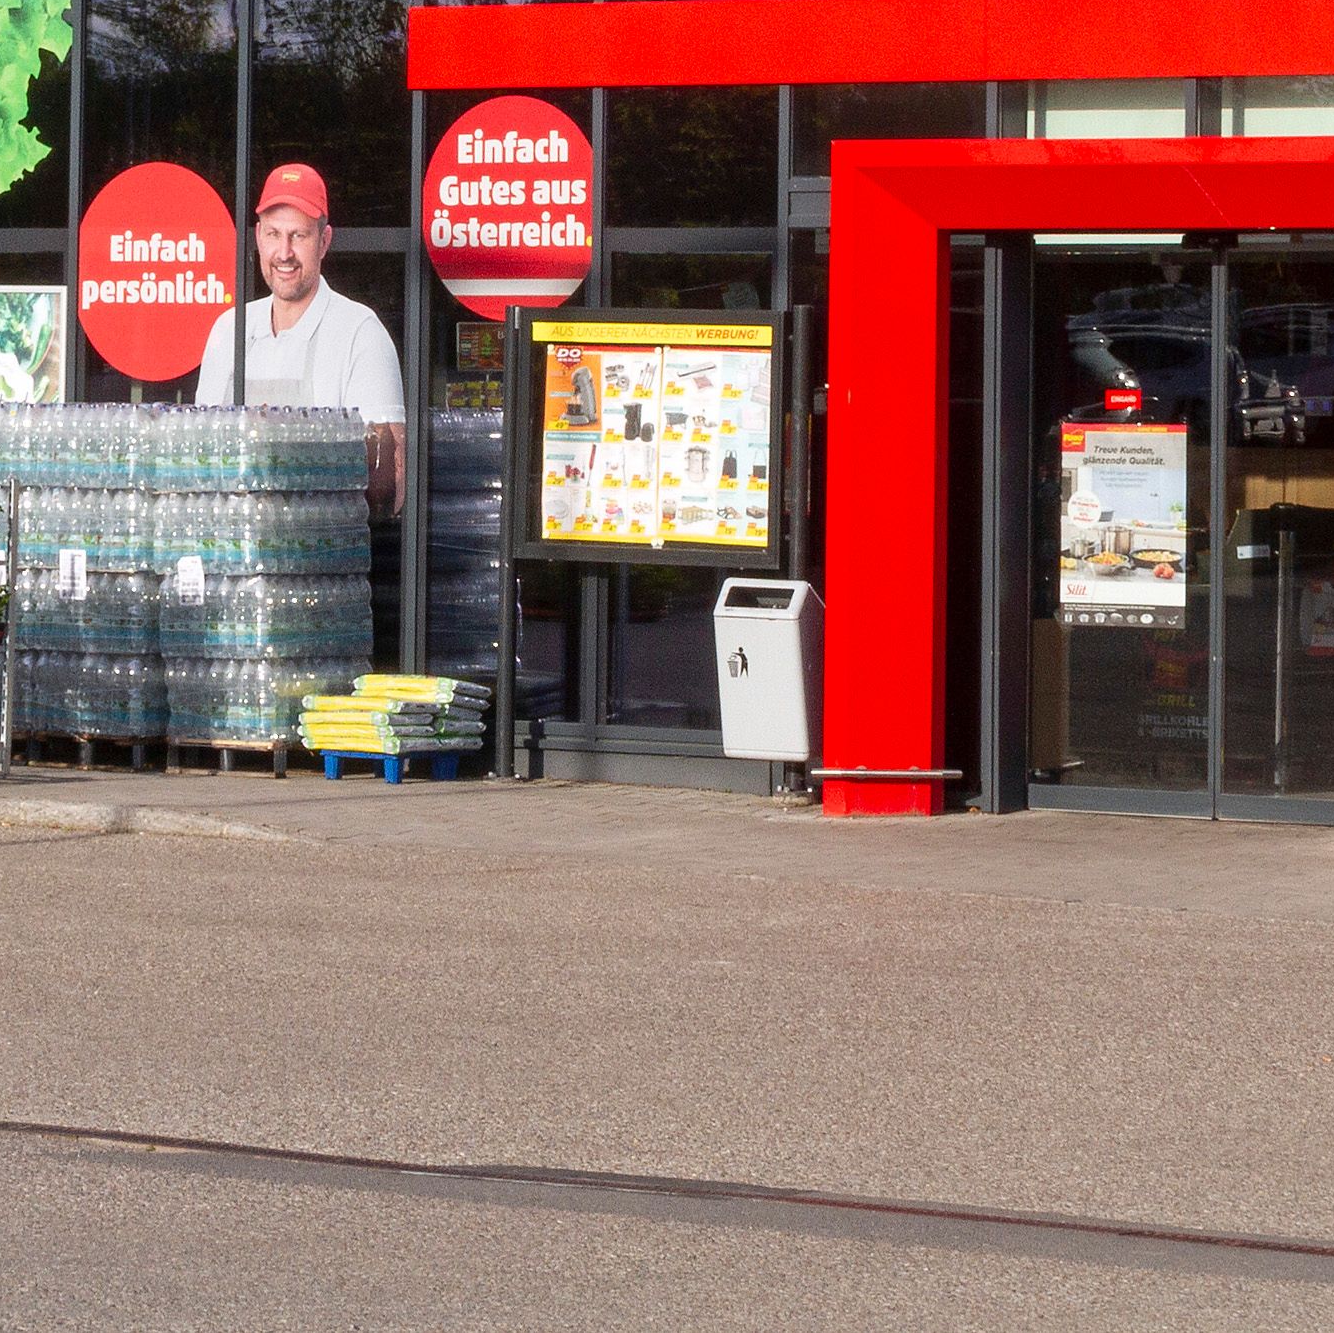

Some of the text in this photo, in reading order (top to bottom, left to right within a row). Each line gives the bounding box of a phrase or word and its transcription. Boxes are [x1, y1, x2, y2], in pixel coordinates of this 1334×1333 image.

[457, 128, 569, 164] Einfach
[439, 175, 587, 206] Gutes aus
[430, 208, 593, 248] Österreich.
[110, 229, 206, 263] Einfach
[81, 270, 233, 310] persönlich.
[552, 325, 759, 340] AUS UNSERER NÄCHSTEN WERBUNG!
[1082, 456, 1166, 466] glänzende Qualität.
[1094, 446, 1155, 455] Treue Kunden,
